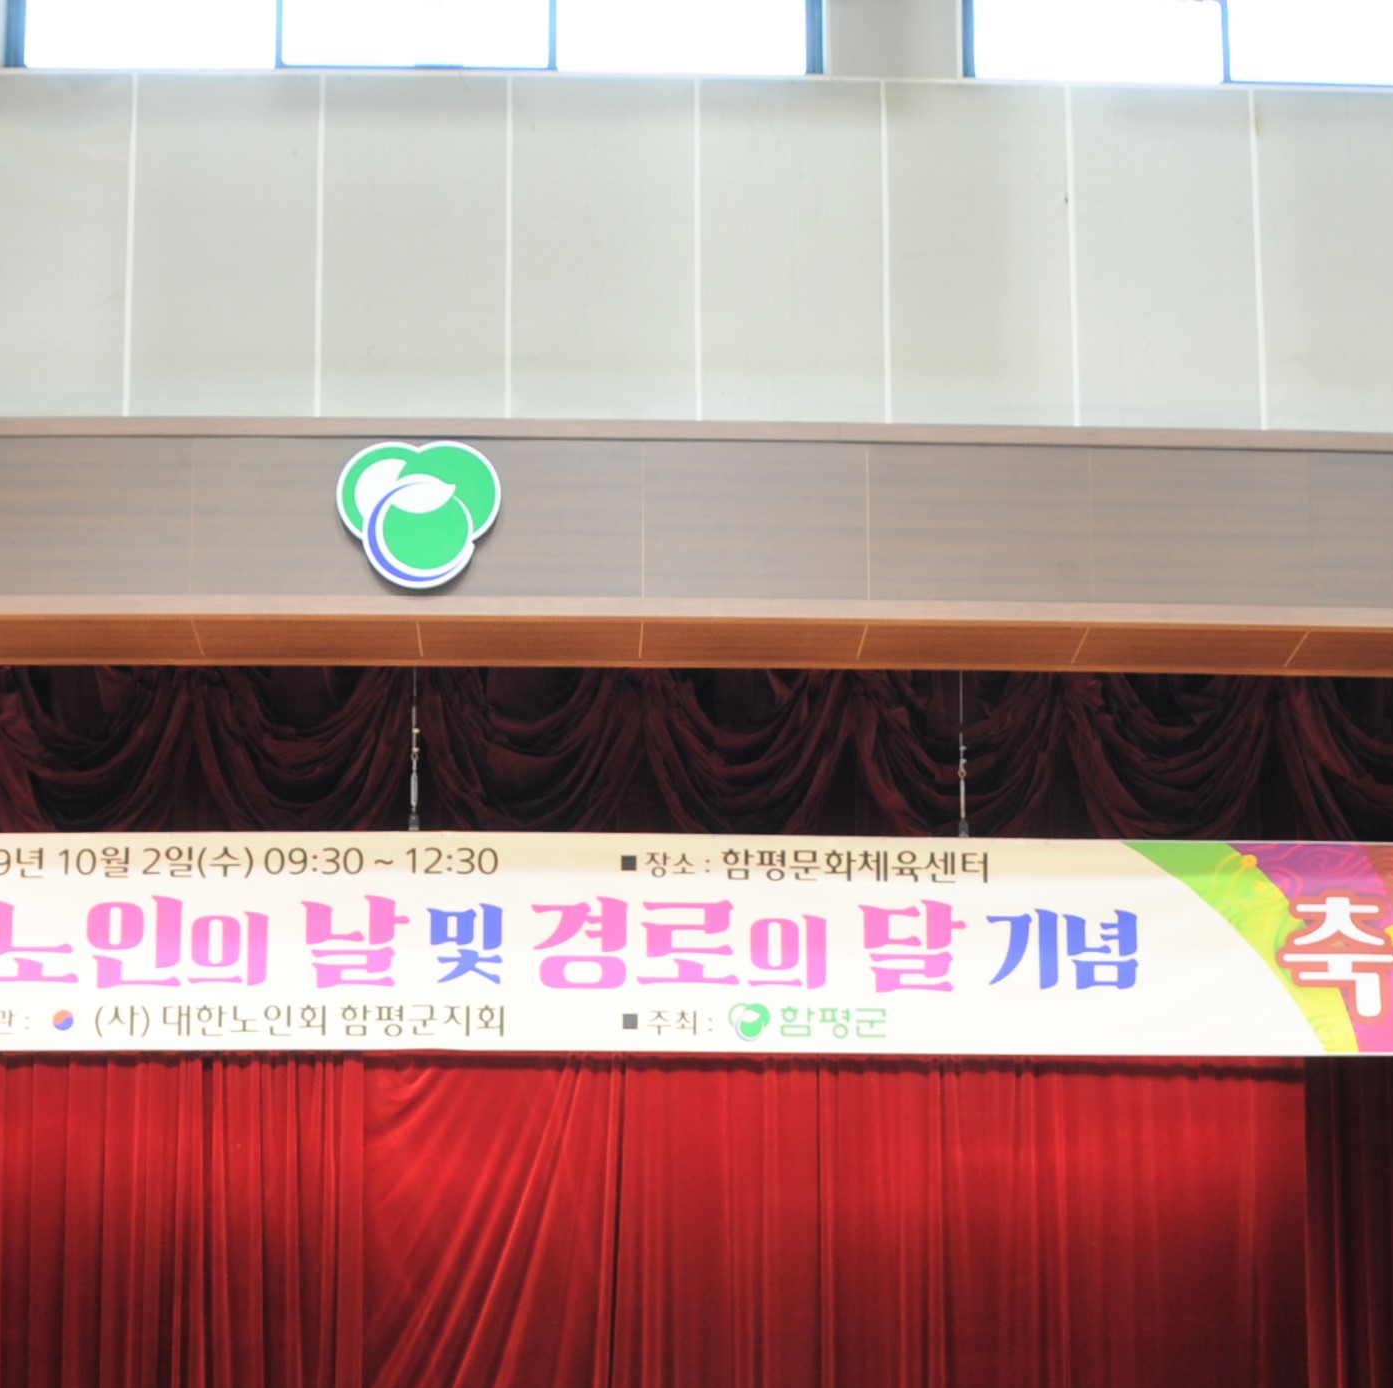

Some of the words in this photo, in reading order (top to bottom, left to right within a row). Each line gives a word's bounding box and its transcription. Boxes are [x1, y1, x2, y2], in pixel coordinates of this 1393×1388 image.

[58, 846, 130, 878] 10월
[141, 846, 254, 878] 2일(수)
[264, 847, 364, 875] 09:30
[405, 847, 499, 875] 12:30
[721, 848, 989, 883] 함평문화체육센터
[300, 894, 410, 988] 날
[426, 902, 503, 985] 및
[531, 895, 827, 990] 경로의
[857, 899, 967, 993] 달
[985, 908, 1139, 990] 기념
[94, 1005, 151, 1038] (사)
[162, 1004, 327, 1037] 대한노인회
[341, 1004, 505, 1038] 함평군지회
[779, 1005, 887, 1039] 함평군
